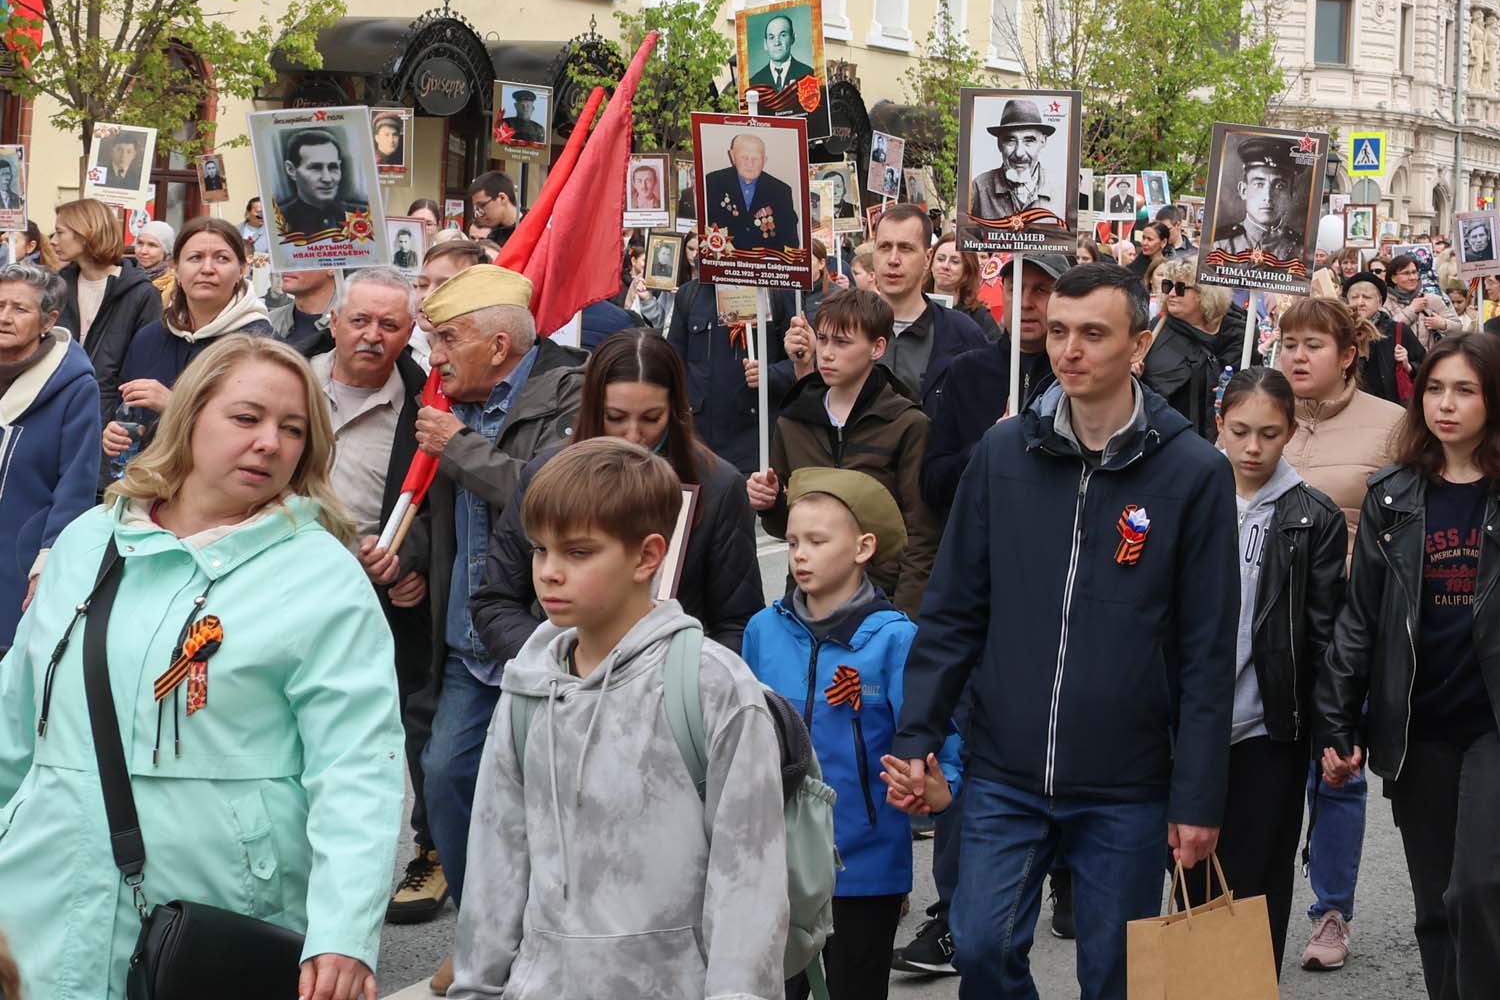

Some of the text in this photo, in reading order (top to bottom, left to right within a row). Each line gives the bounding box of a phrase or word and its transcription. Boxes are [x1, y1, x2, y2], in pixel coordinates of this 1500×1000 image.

[420, 70, 466, 98] Giuseppe
[987, 232, 1046, 242] ШАГАЛИЕВ
[306, 243, 354, 251] МАРТЫНОВ
[963, 240, 1069, 251] Мирзагали Шагалиевич
[316, 250, 370, 258] САВЕЛЬЕВИЧ
[724, 269, 754, 277] 01.02.1925
[1216, 265, 1293, 282] ГИМАЛТДИНОВ
[711, 275, 758, 285] Красноармеец
[1200, 273, 1306, 293] Ризатдин Гималтдинович
[1430, 549, 1461, 562] AMERICAN
